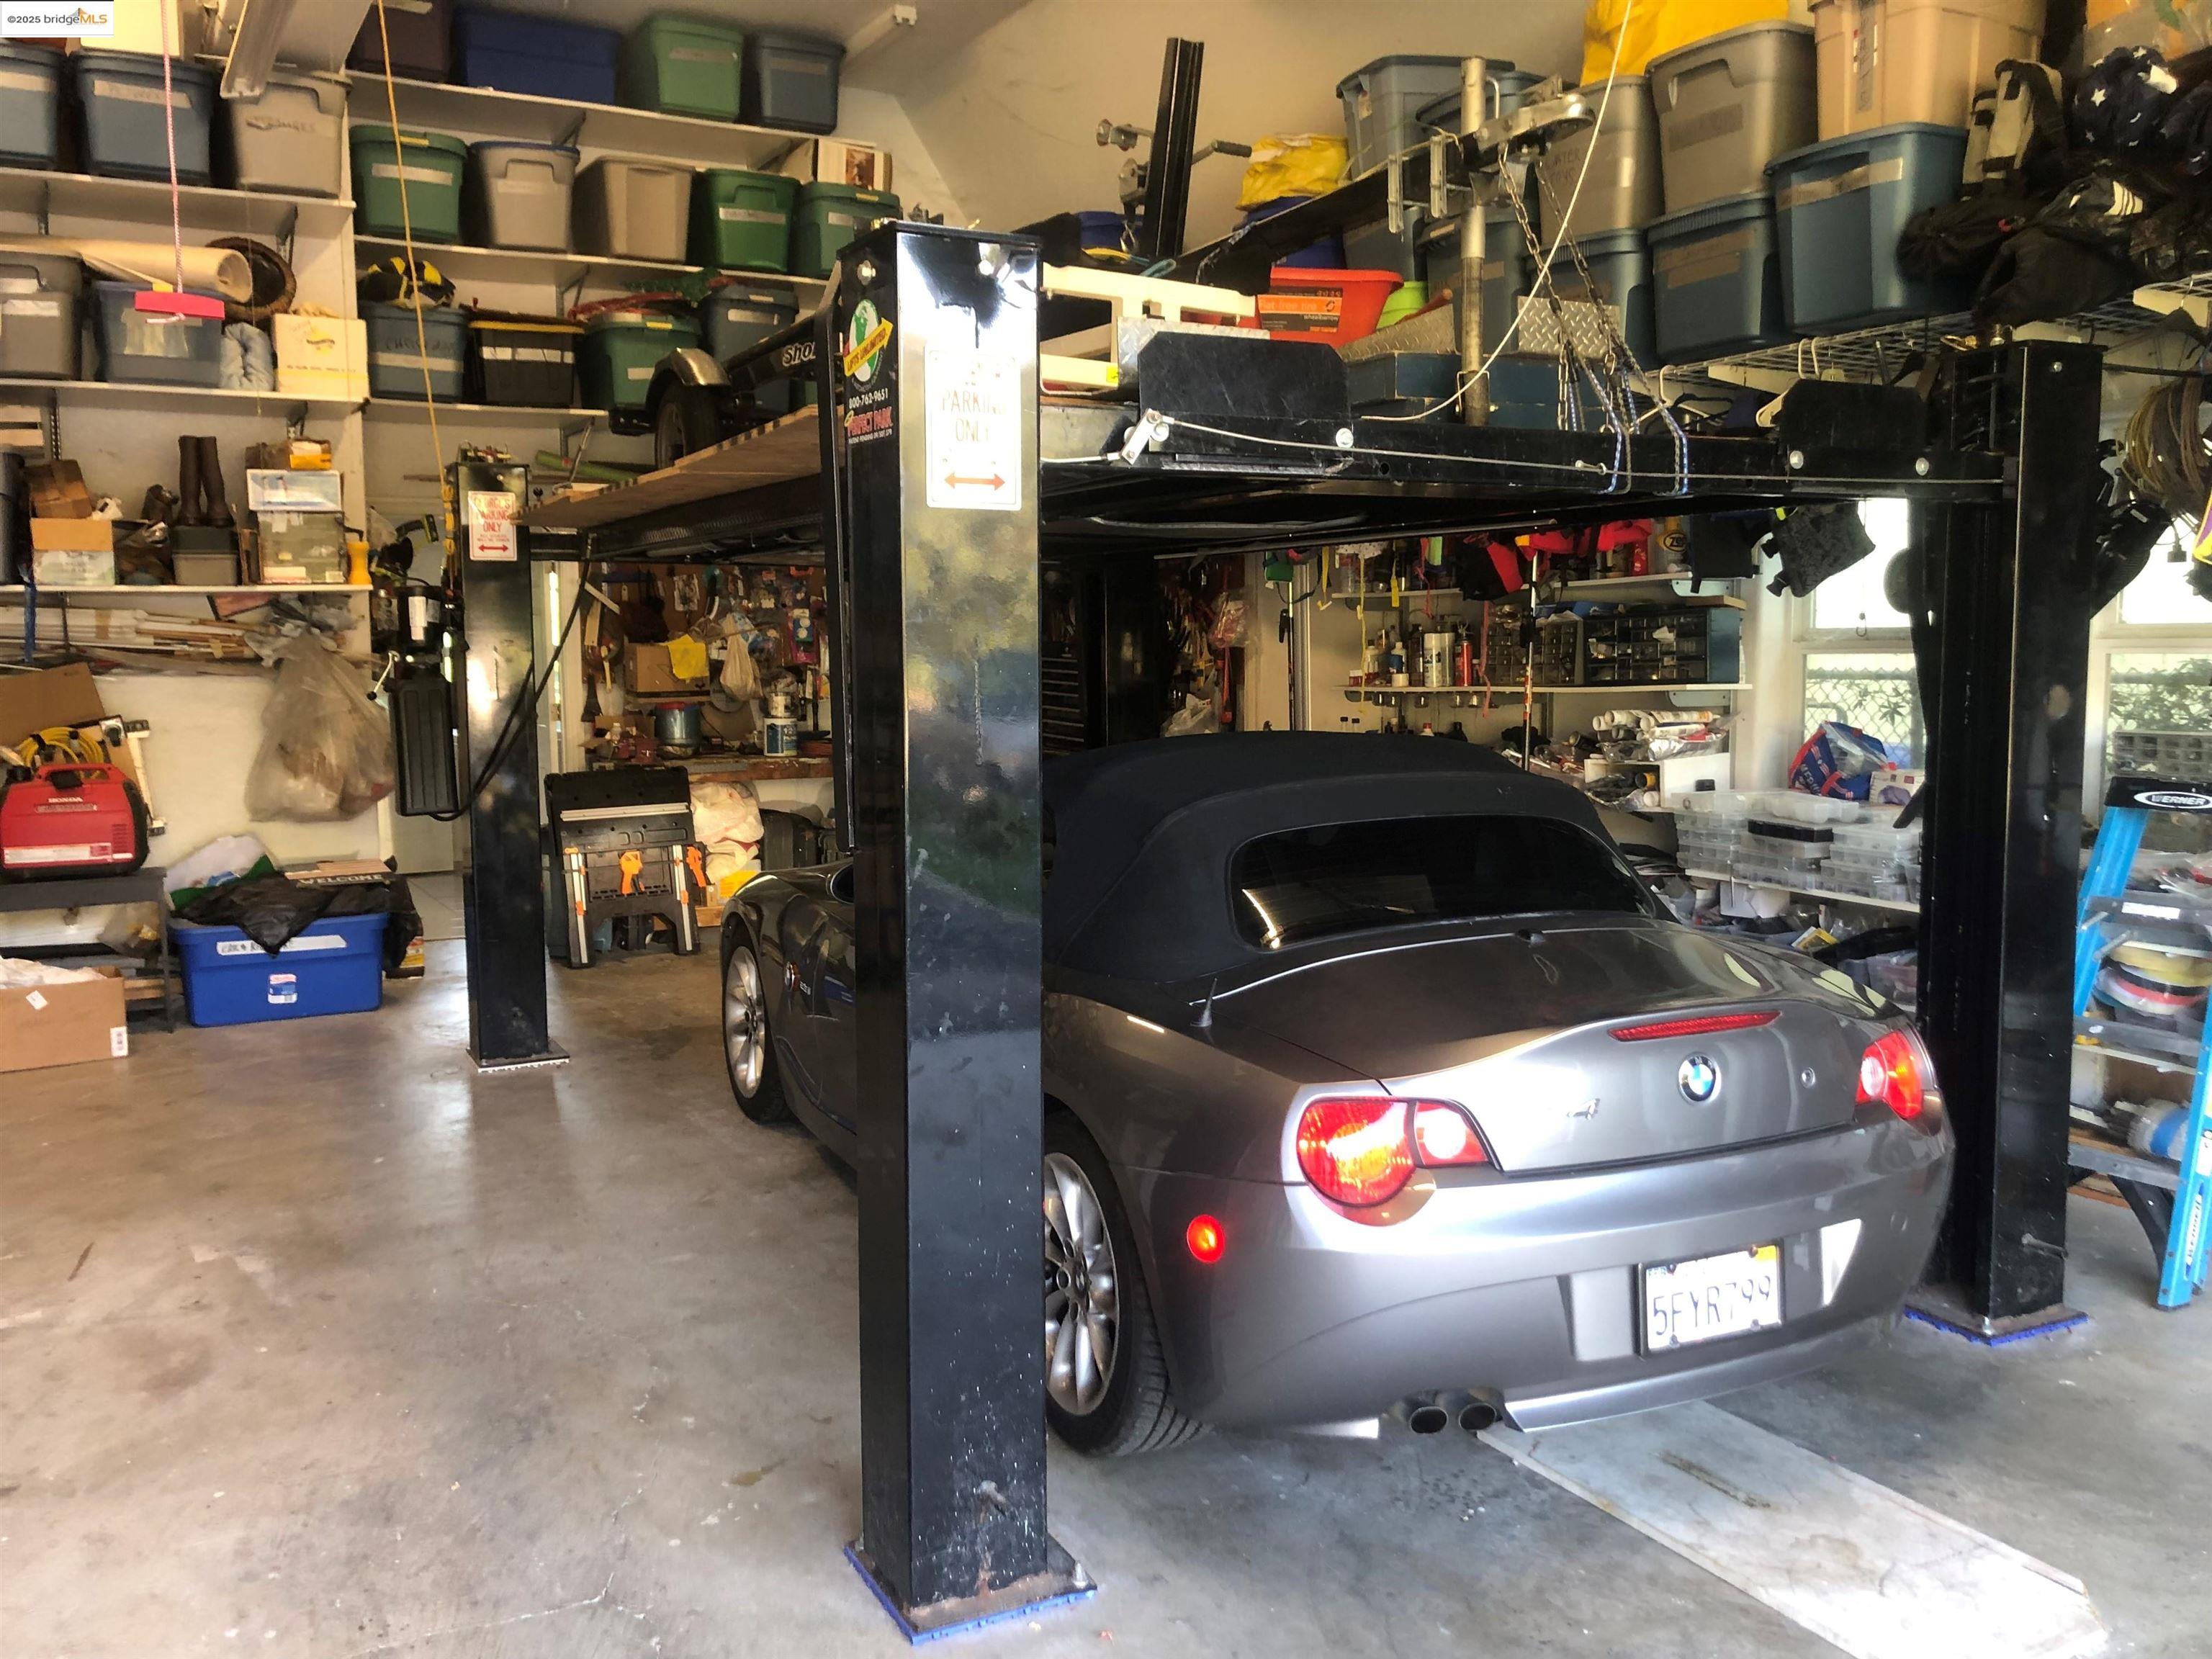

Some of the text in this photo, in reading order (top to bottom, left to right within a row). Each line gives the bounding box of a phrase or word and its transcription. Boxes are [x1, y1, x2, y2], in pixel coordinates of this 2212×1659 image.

[783, 342, 816, 367] Sho
[848, 387, 889, 410] 800-762-9651
[942, 390, 1007, 414] PARKI
[482, 521, 503, 533] ONLY
[2151, 794, 2206, 805] WERNER
[299, 874, 382, 884] WELCOME
[1653, 1275, 1771, 1336] 5FYR799
